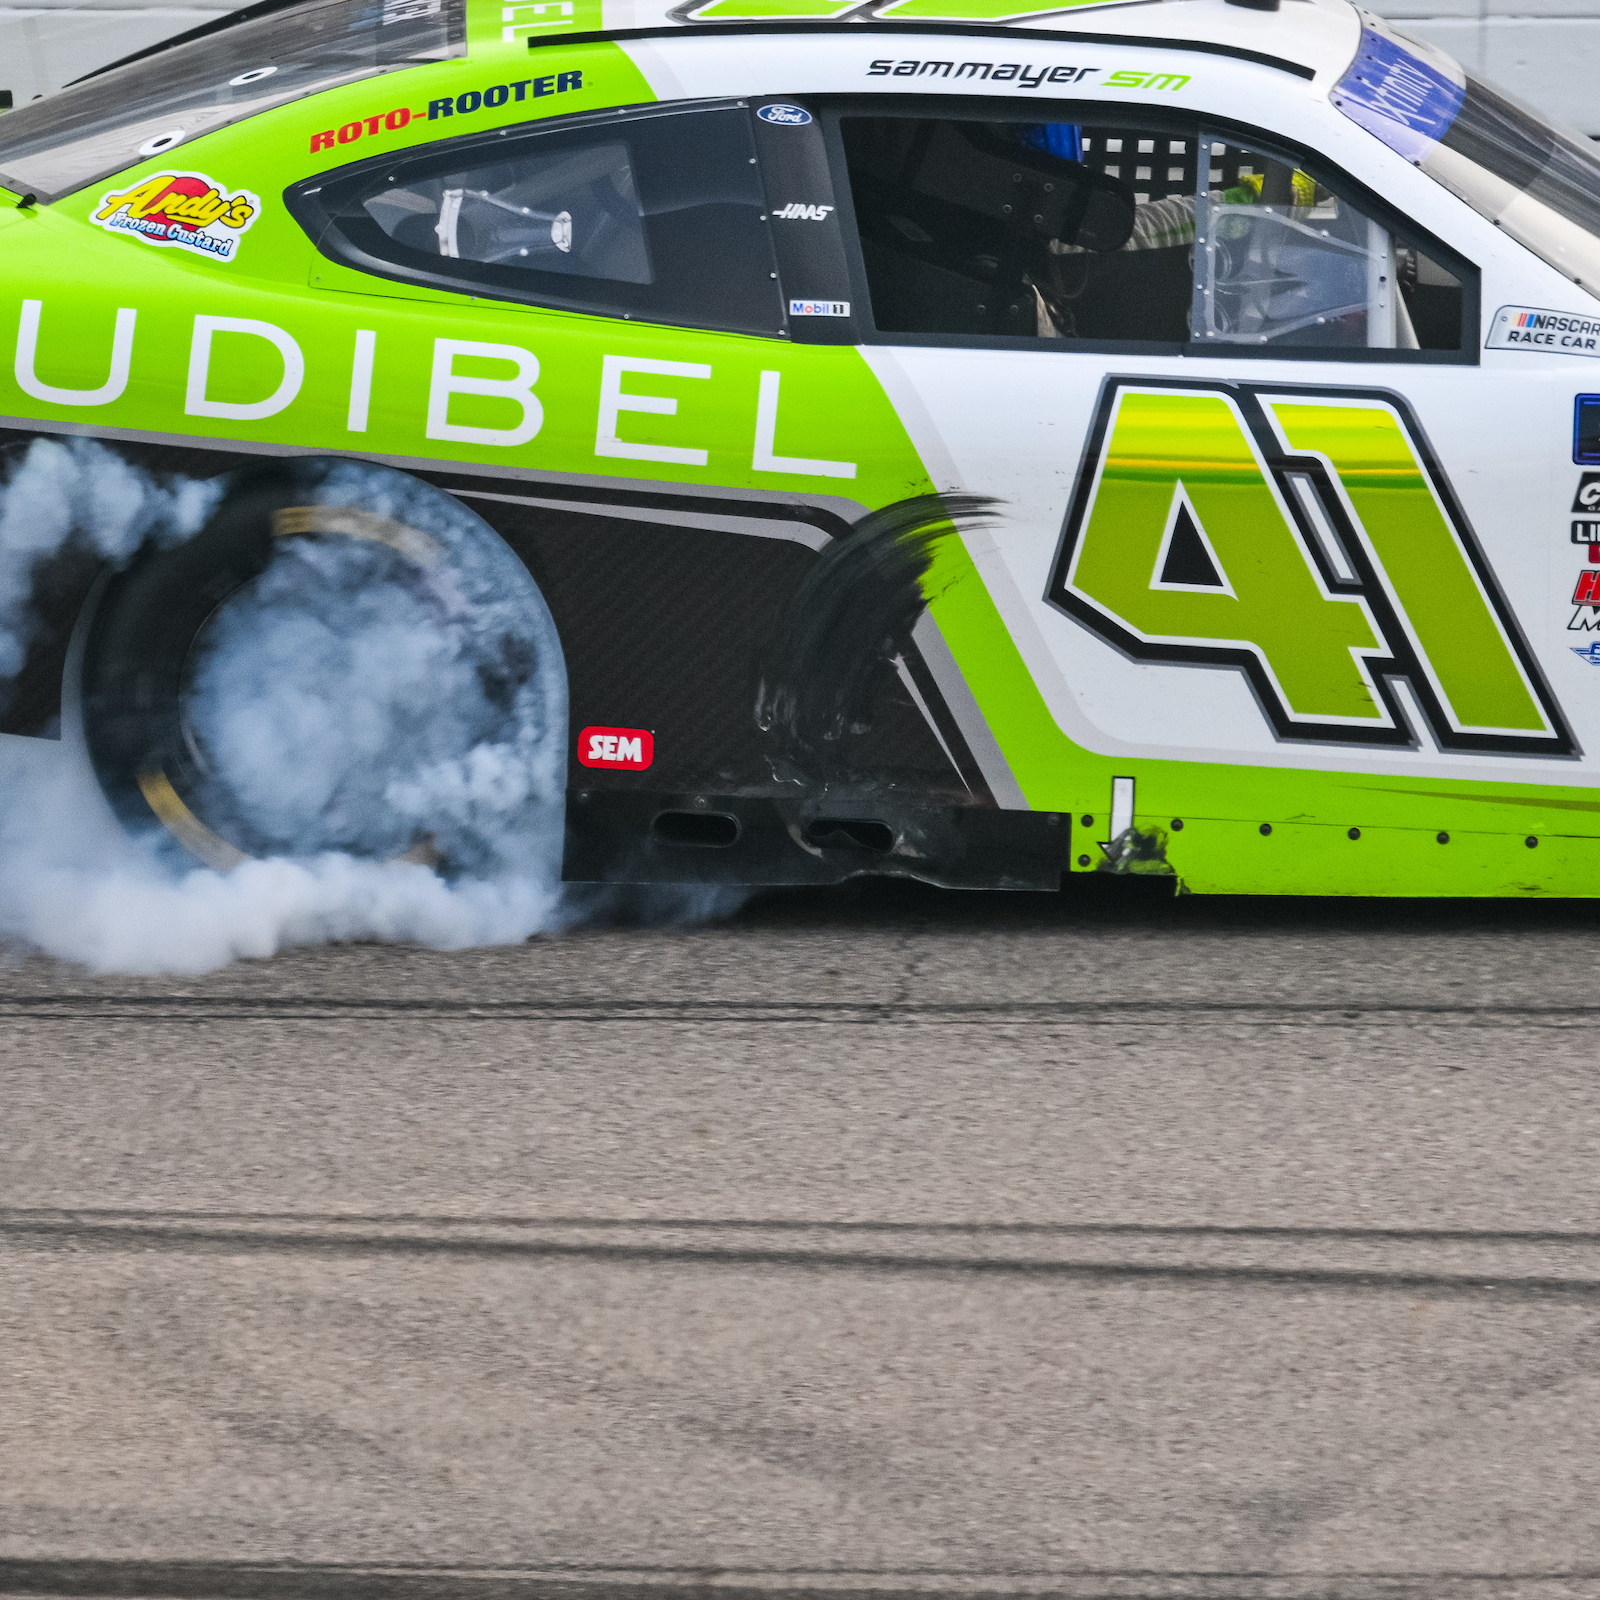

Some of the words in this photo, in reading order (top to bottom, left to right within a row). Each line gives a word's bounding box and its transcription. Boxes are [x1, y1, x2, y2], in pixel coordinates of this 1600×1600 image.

[309, 70, 583, 154] ROTO-ROOTER
[767, 105, 803, 123] Ford
[95, 175, 255, 229] Andy's
[771, 203, 835, 221] HAAS
[109, 211, 165, 237] Frozen
[166, 222, 234, 257] Custard
[792, 303, 830, 314] Mobil
[1508, 330, 1556, 345] RACE
[1560, 335, 1597, 350] CAR
[1042, 372, 1586, 762] 41
[588, 735, 642, 762] SEM
